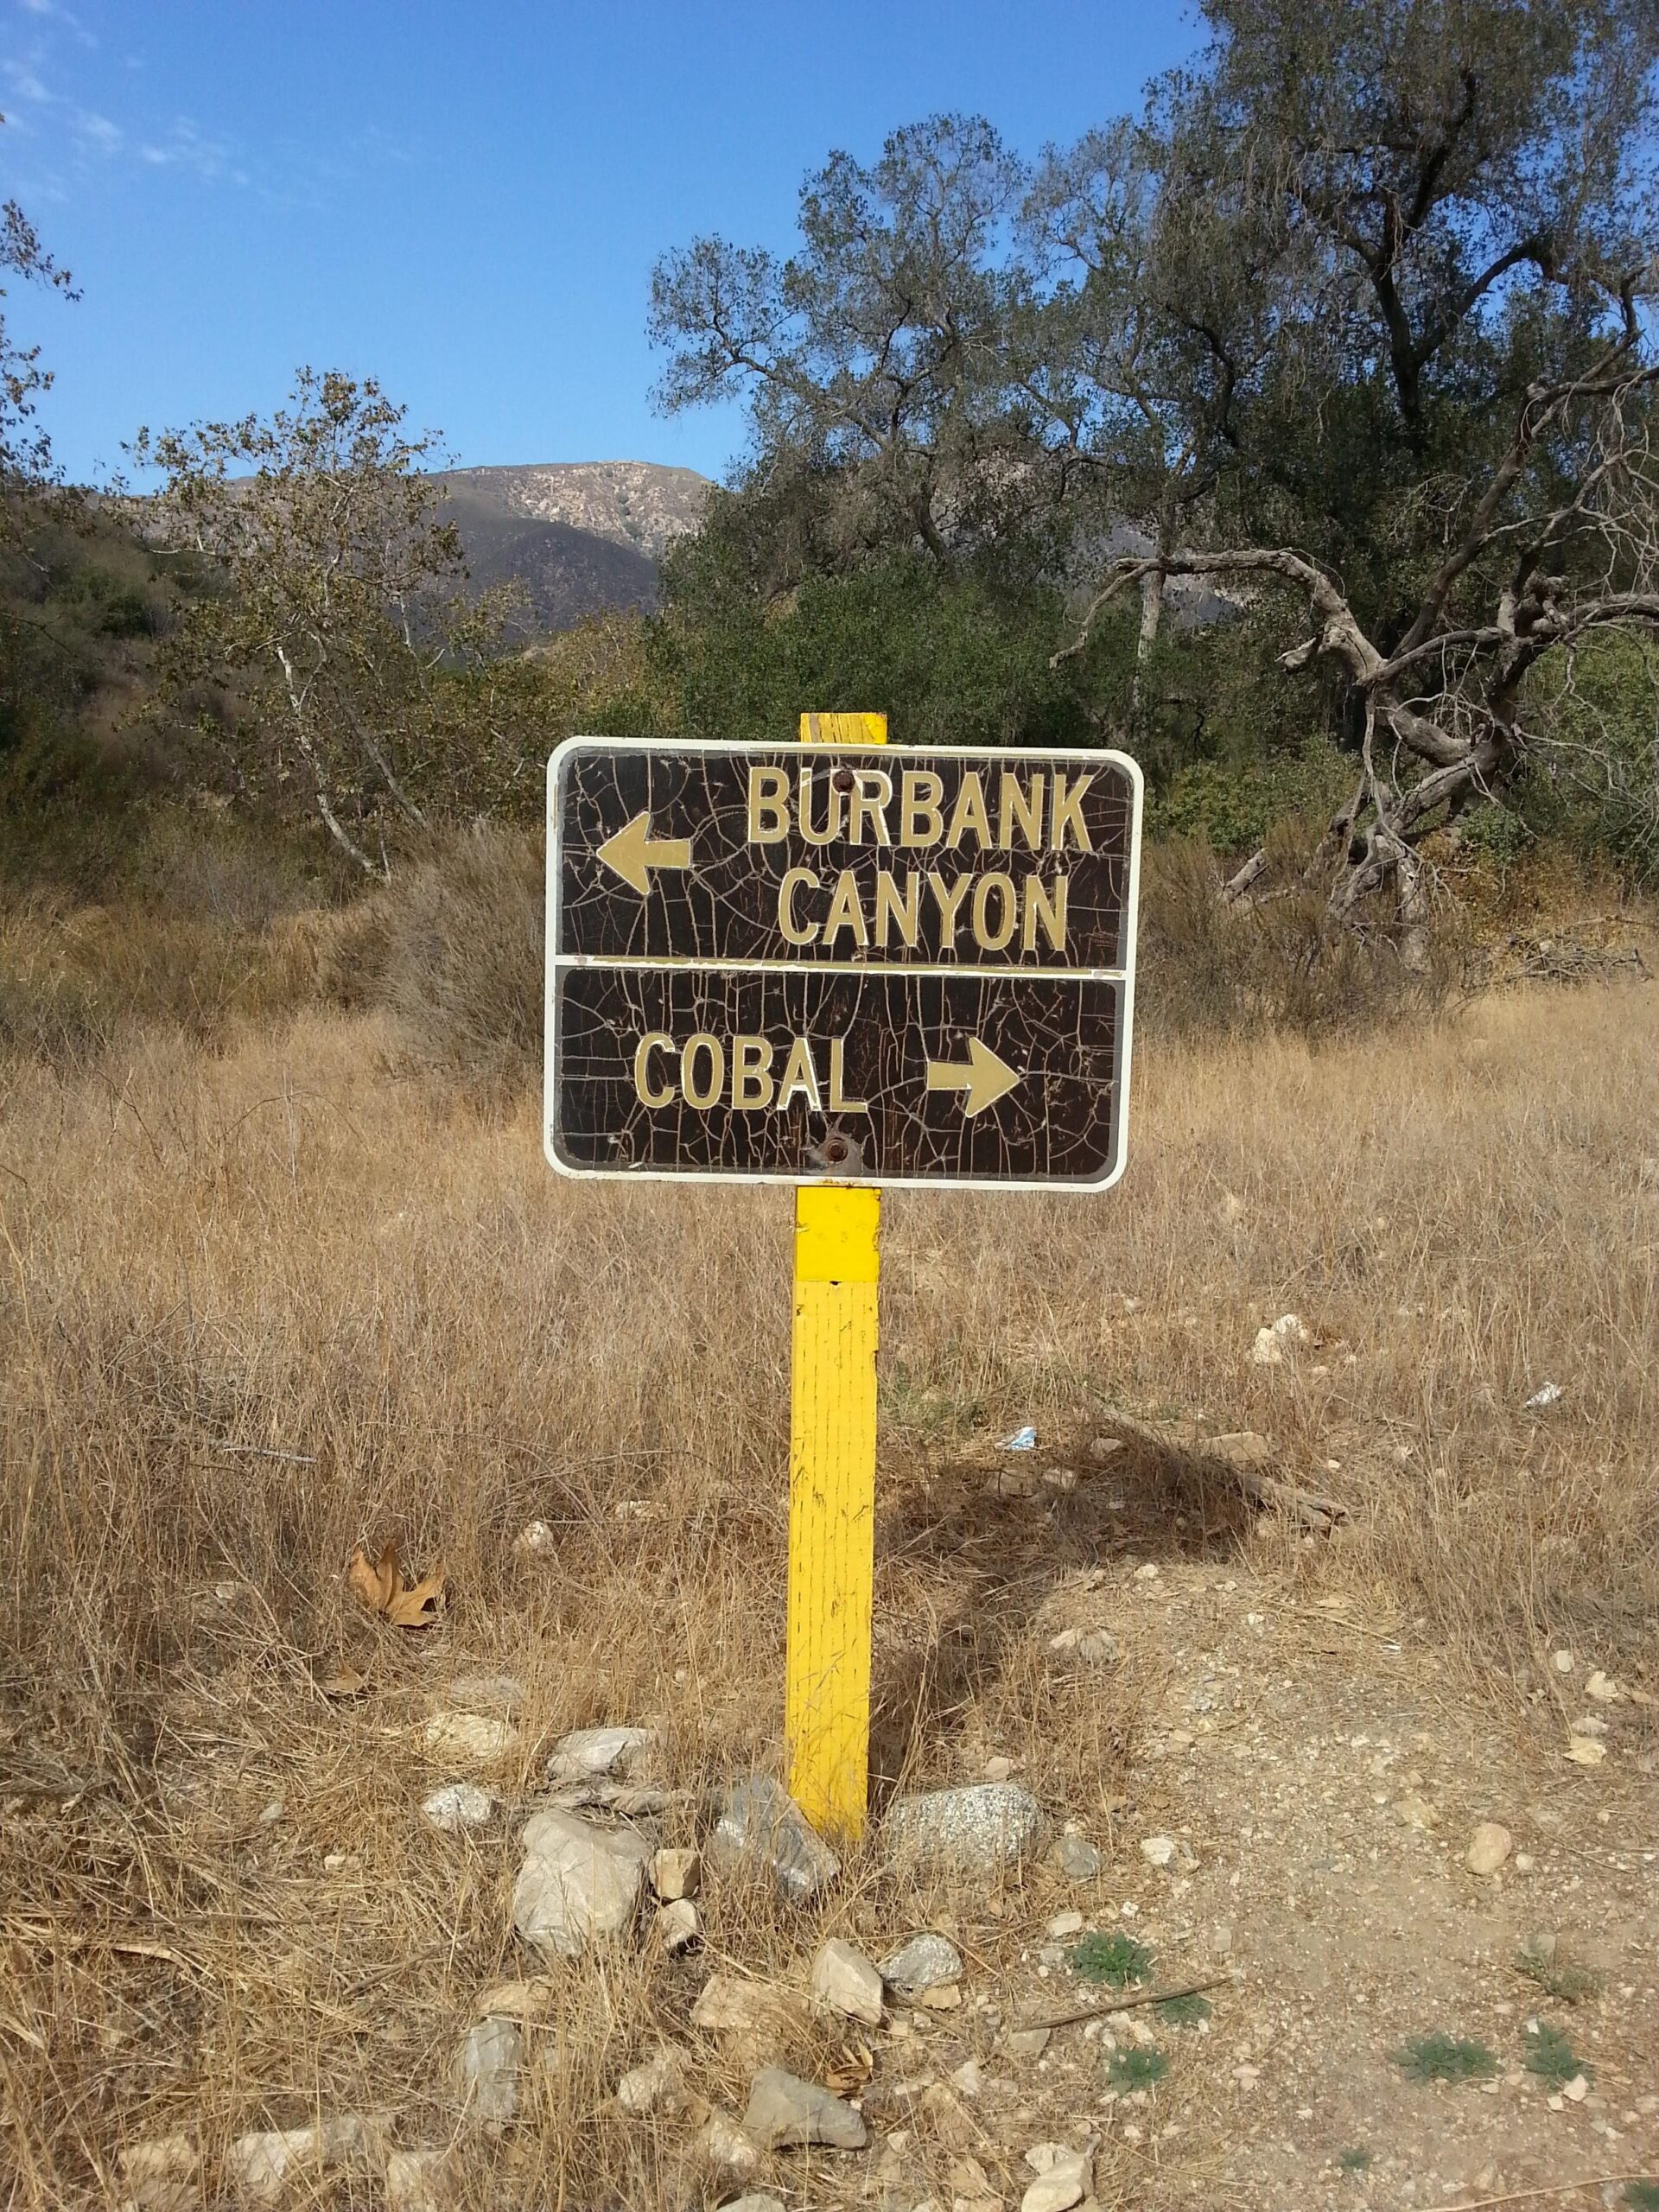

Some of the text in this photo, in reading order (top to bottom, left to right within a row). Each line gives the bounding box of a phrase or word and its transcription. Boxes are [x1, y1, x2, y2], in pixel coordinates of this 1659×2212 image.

[747, 766, 1095, 852] BURBANK
[777, 868, 1067, 951] CANYON
[633, 1032, 868, 1113] COBAL
